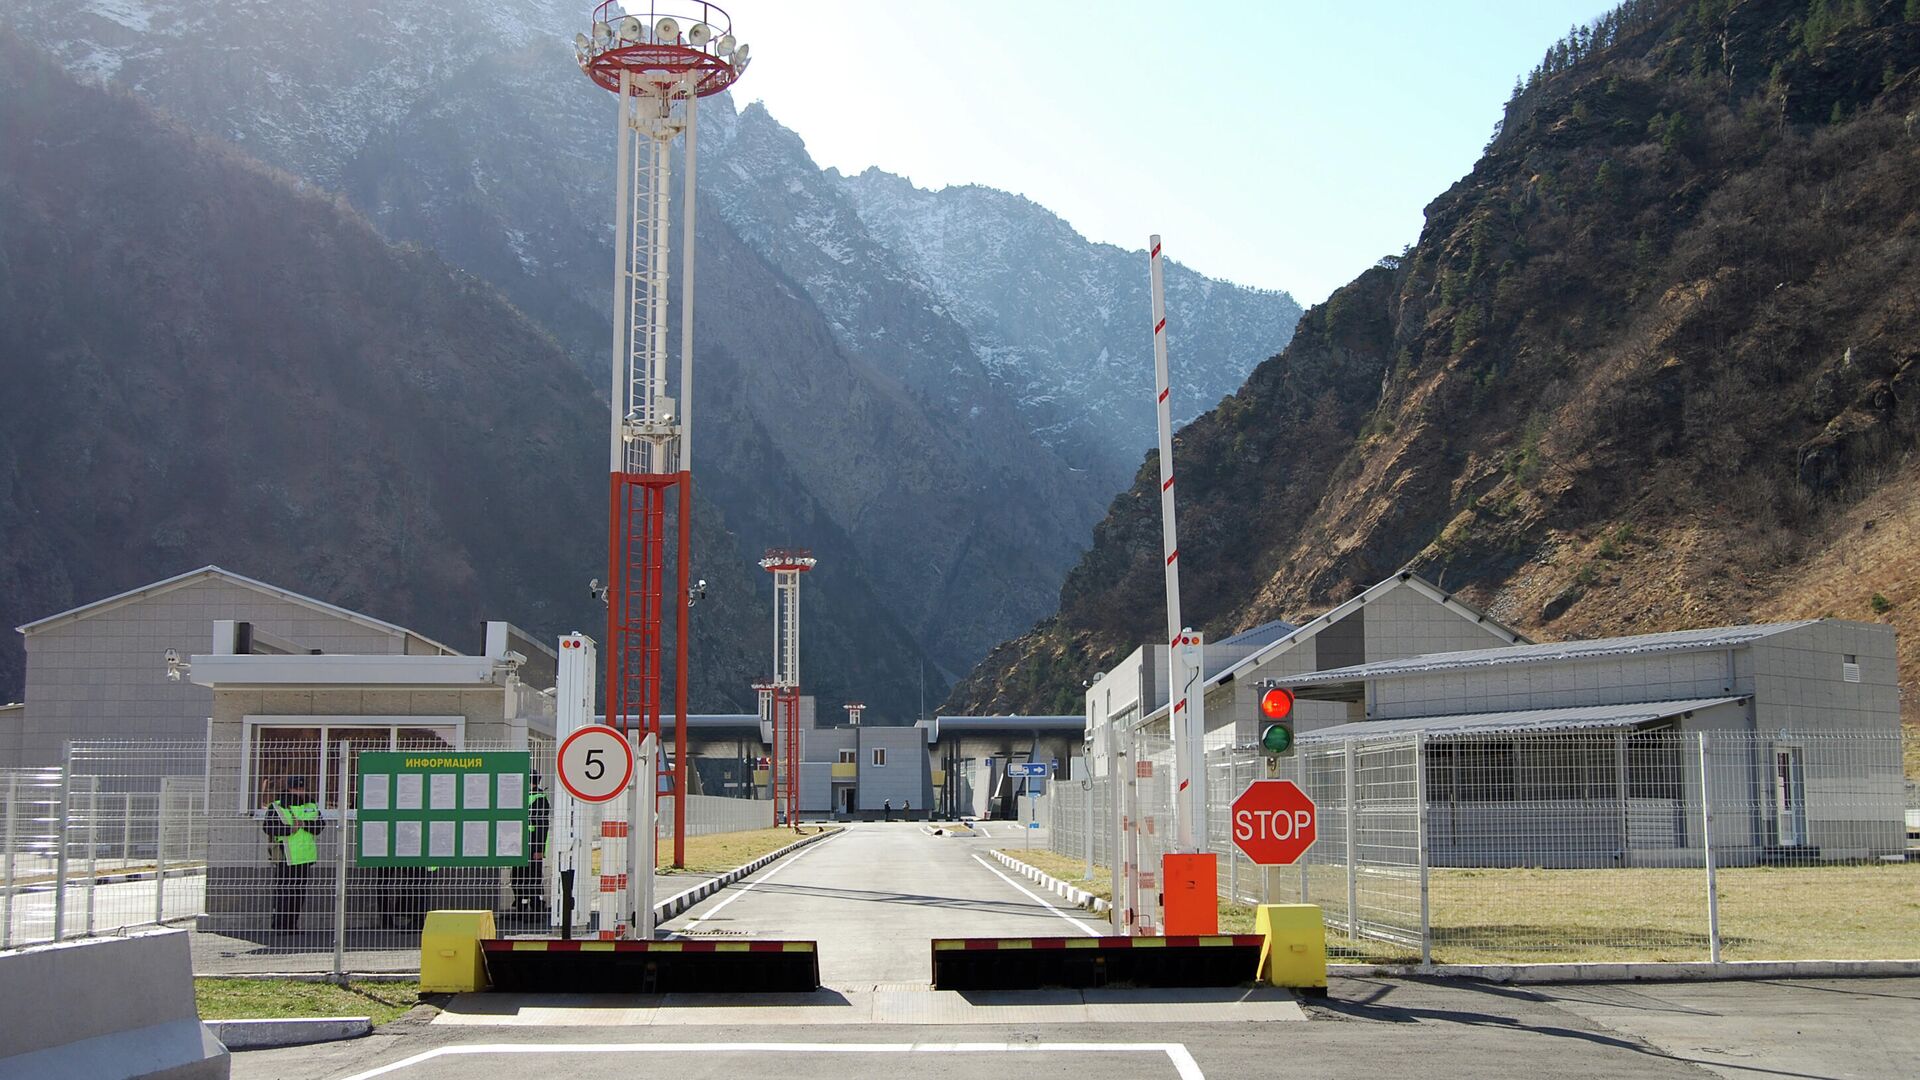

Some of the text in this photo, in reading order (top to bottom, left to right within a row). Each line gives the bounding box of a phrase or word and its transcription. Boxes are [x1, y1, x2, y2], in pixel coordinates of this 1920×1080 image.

[405, 758, 483, 769] ИНФОРМАЦИЯ
[585, 750, 604, 780] 5
[1235, 810, 1311, 841] STOP
